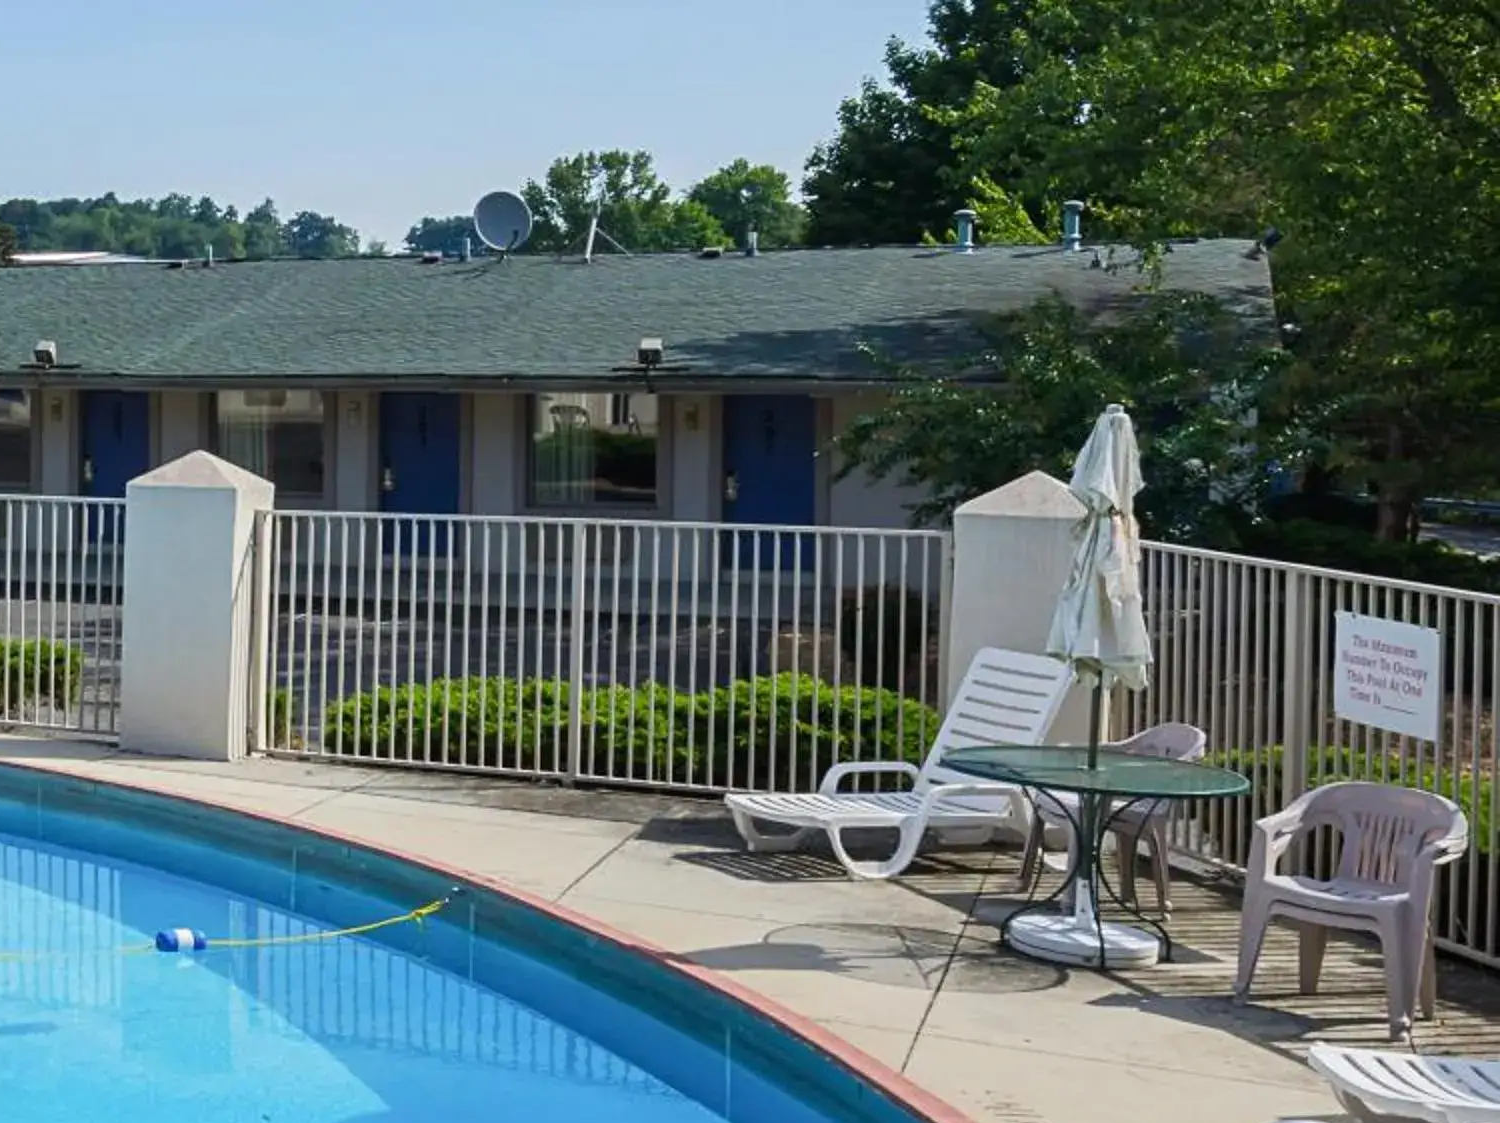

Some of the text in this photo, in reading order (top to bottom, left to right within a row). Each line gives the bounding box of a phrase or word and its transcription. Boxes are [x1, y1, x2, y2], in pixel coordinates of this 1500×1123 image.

[1352, 633, 1418, 659] The Maximum
[1342, 650, 1428, 680] Number To Occupy
[1347, 669, 1423, 698] This Pool At One
